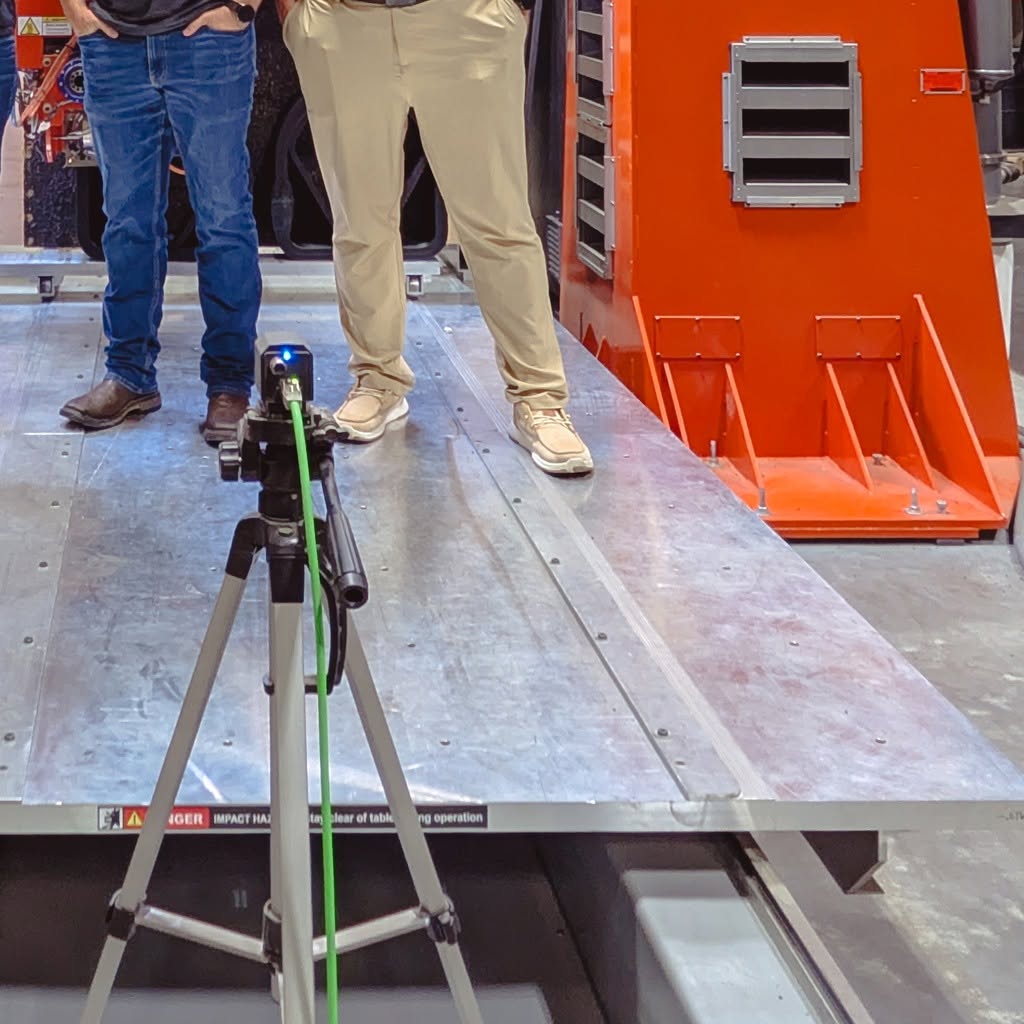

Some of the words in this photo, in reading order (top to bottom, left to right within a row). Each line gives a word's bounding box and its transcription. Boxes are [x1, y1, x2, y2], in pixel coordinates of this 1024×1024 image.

[168, 812, 203, 825] NGER
[213, 813, 251, 825] IMPACT
[253, 813, 272, 825] HAZ
[310, 812, 324, 826] tay
[331, 812, 354, 824] lear
[356, 812, 367, 824] of
[433, 812, 484, 825] operation
